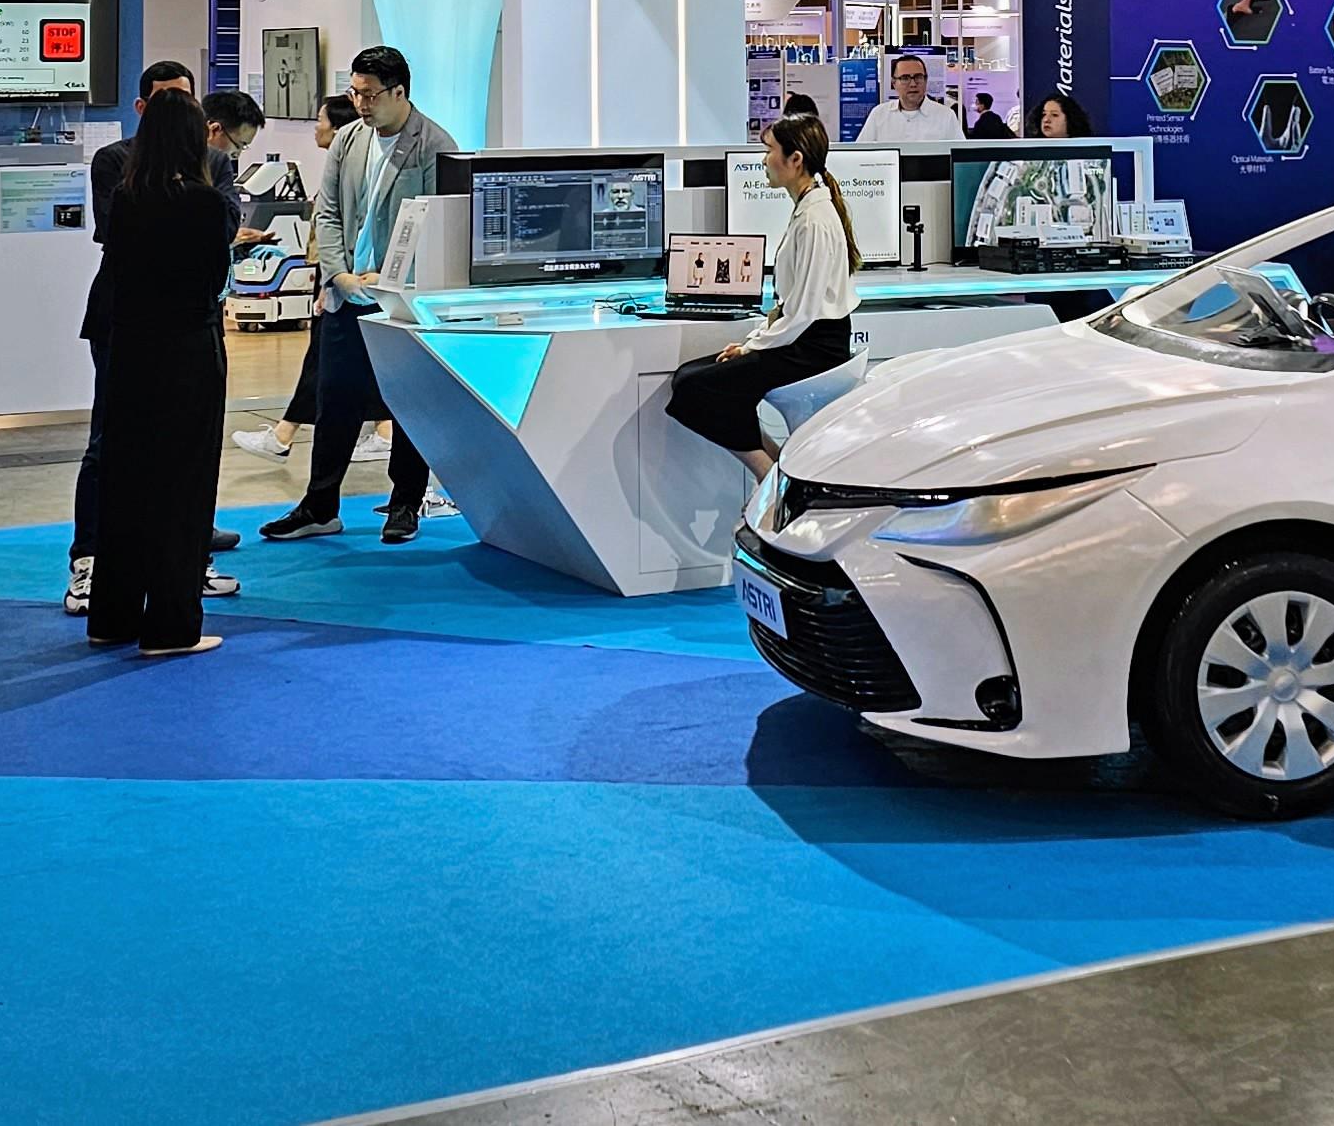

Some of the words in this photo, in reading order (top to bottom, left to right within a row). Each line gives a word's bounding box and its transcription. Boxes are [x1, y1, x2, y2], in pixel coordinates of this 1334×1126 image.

[47, 27, 77, 37] STOP
[841, 189, 885, 198] chnologies
[742, 578, 777, 623] ASTRI
